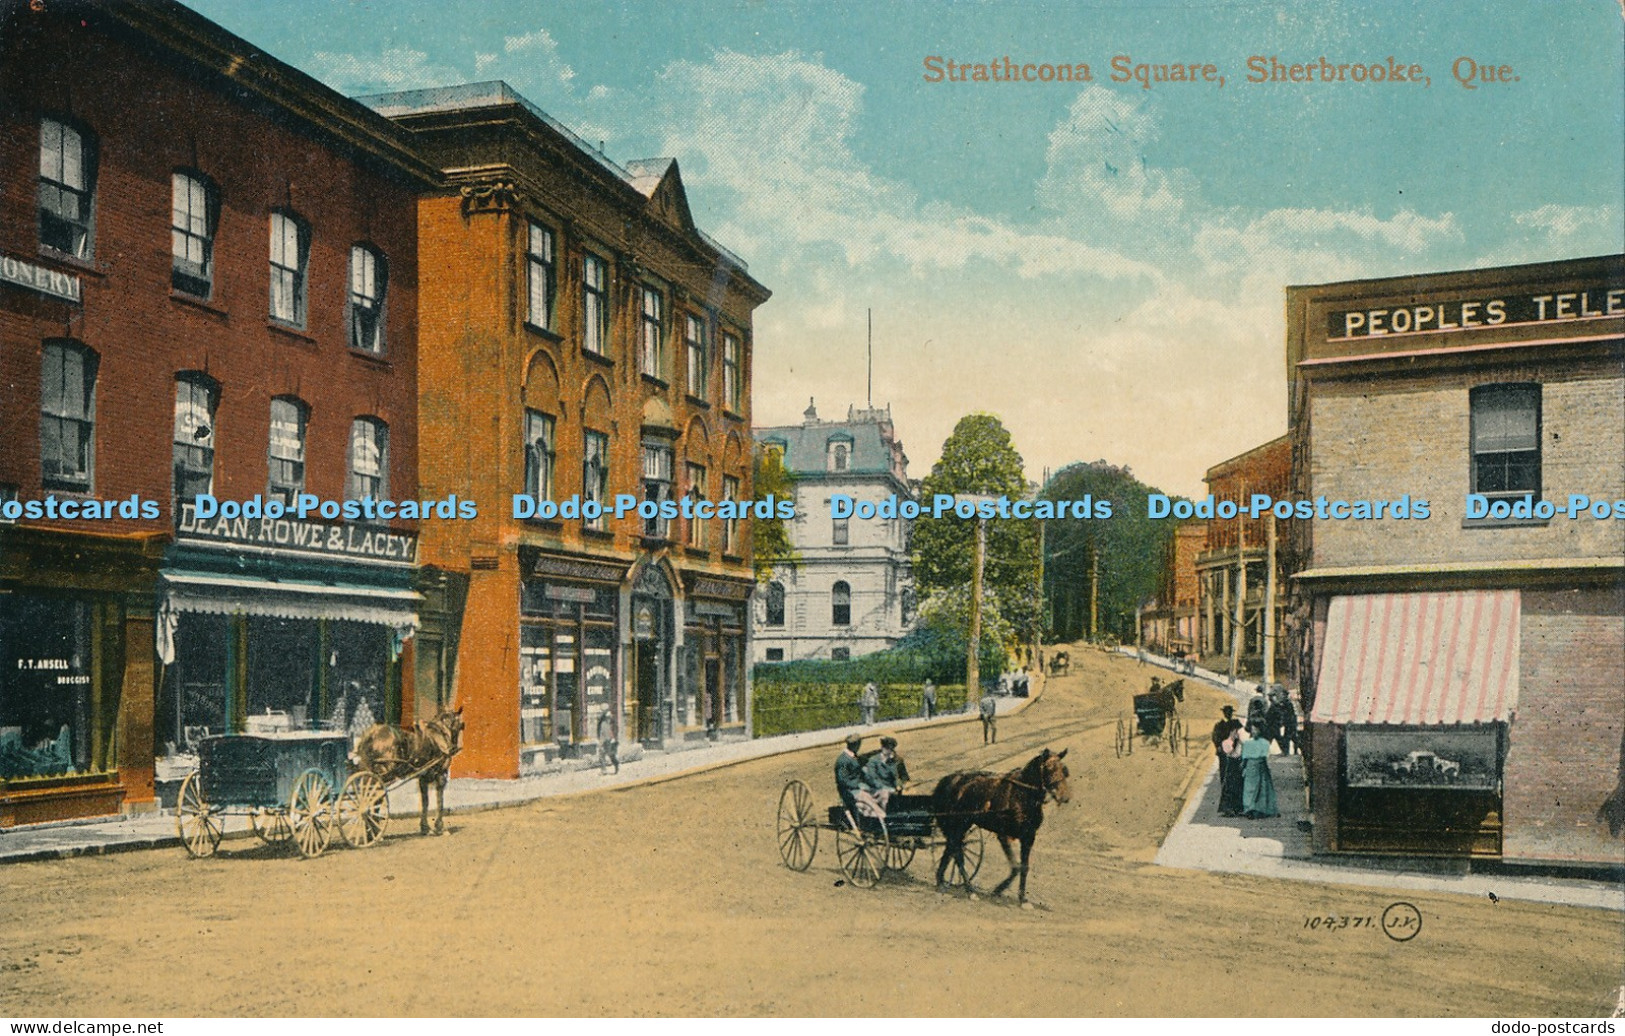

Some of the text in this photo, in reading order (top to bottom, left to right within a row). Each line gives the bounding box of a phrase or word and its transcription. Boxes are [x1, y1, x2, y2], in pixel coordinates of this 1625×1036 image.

[1345, 289, 1625, 338] PEOPLES TELE
[258, 514, 324, 549] ROWE
[327, 526, 345, 551] &
